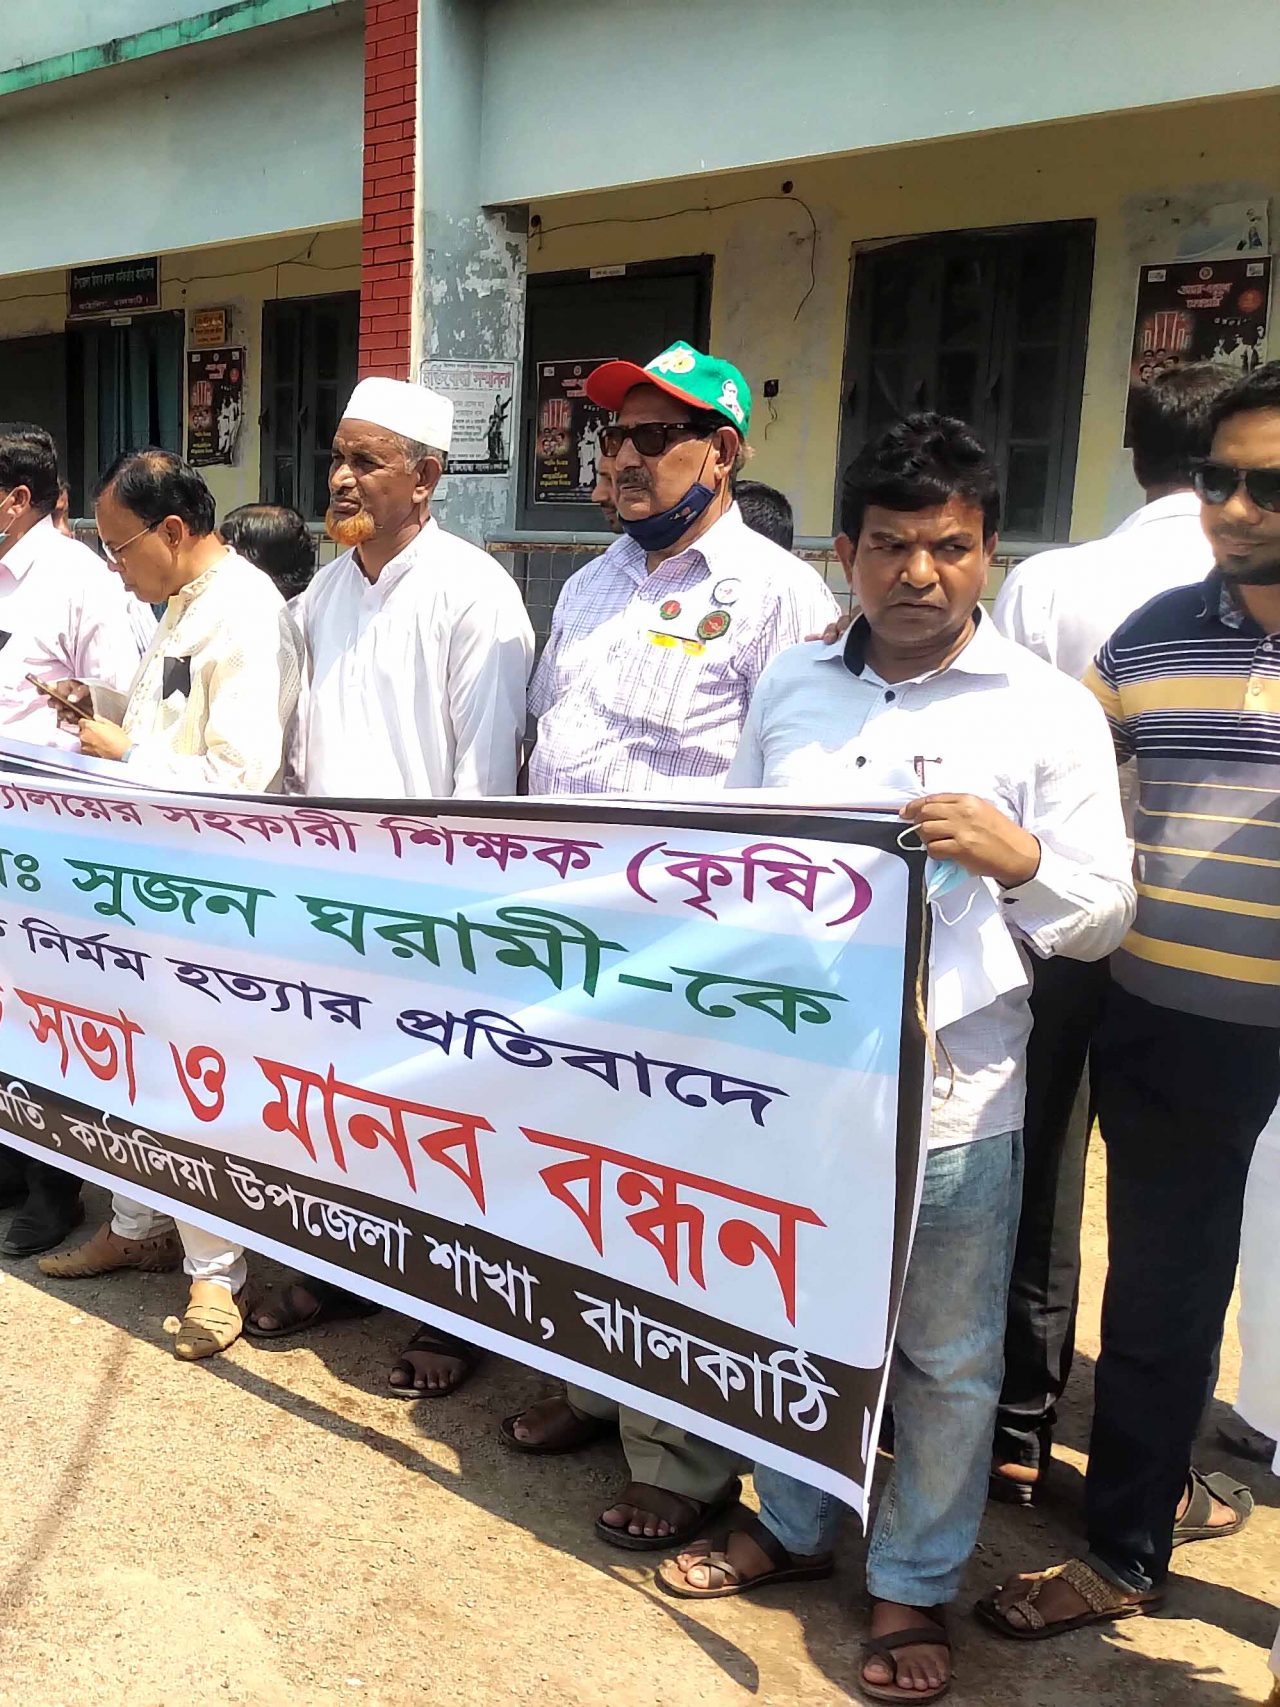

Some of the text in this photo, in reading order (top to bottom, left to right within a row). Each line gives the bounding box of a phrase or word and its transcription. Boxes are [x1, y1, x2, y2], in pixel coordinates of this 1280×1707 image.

[63, 856, 275, 938] সুজন
[155, 804, 360, 854] সহকারী
[381, 815, 603, 880] শিক্ষক
[626, 841, 873, 927] (কৃষি)
[17, 918, 150, 982] নির্মম
[165, 956, 372, 1031] হত্যার
[395, 1008, 790, 1128] প্রতিবাদে
[12, 987, 146, 1107] সভা
[169, 1040, 226, 1123] ও
[253, 1055, 495, 1216] মানব
[518, 1125, 828, 1329] বন্ধন
[61, 1110, 220, 1201] কাঠালিয়া
[224, 1154, 413, 1274] উপজেলা
[422, 1233, 555, 1342] শাখা,
[574, 1289, 841, 1434] ঝালকাঠি
